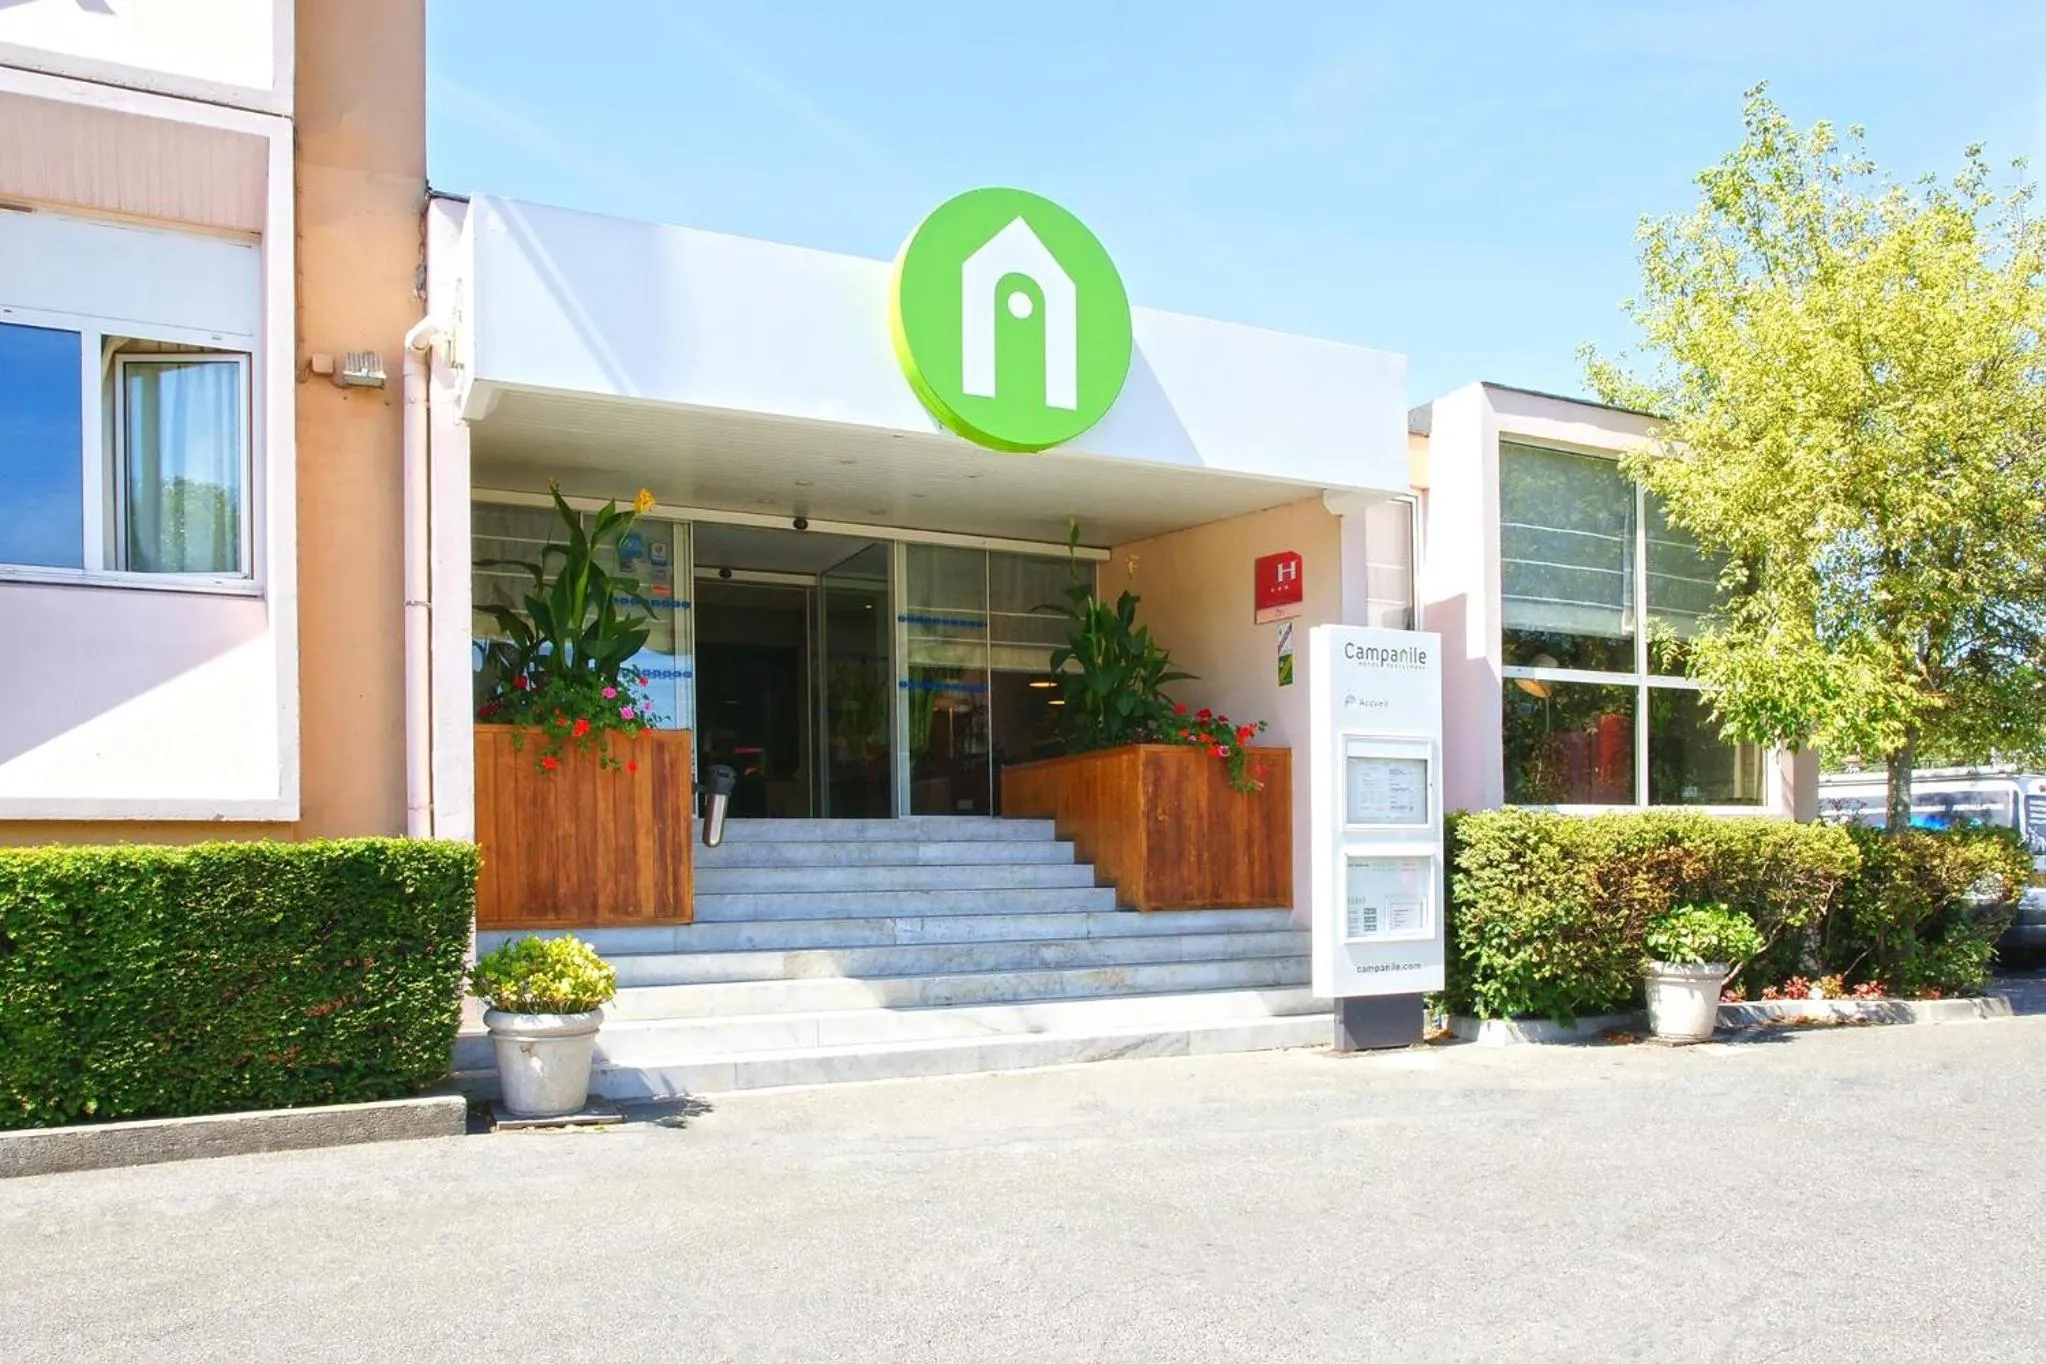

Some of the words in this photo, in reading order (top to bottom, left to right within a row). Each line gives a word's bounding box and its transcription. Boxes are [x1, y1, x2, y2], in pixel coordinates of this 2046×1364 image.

[1277, 561, 1297, 582] H
[1344, 642, 1427, 668] Campanile
[1356, 963, 1422, 974] campanile.com
